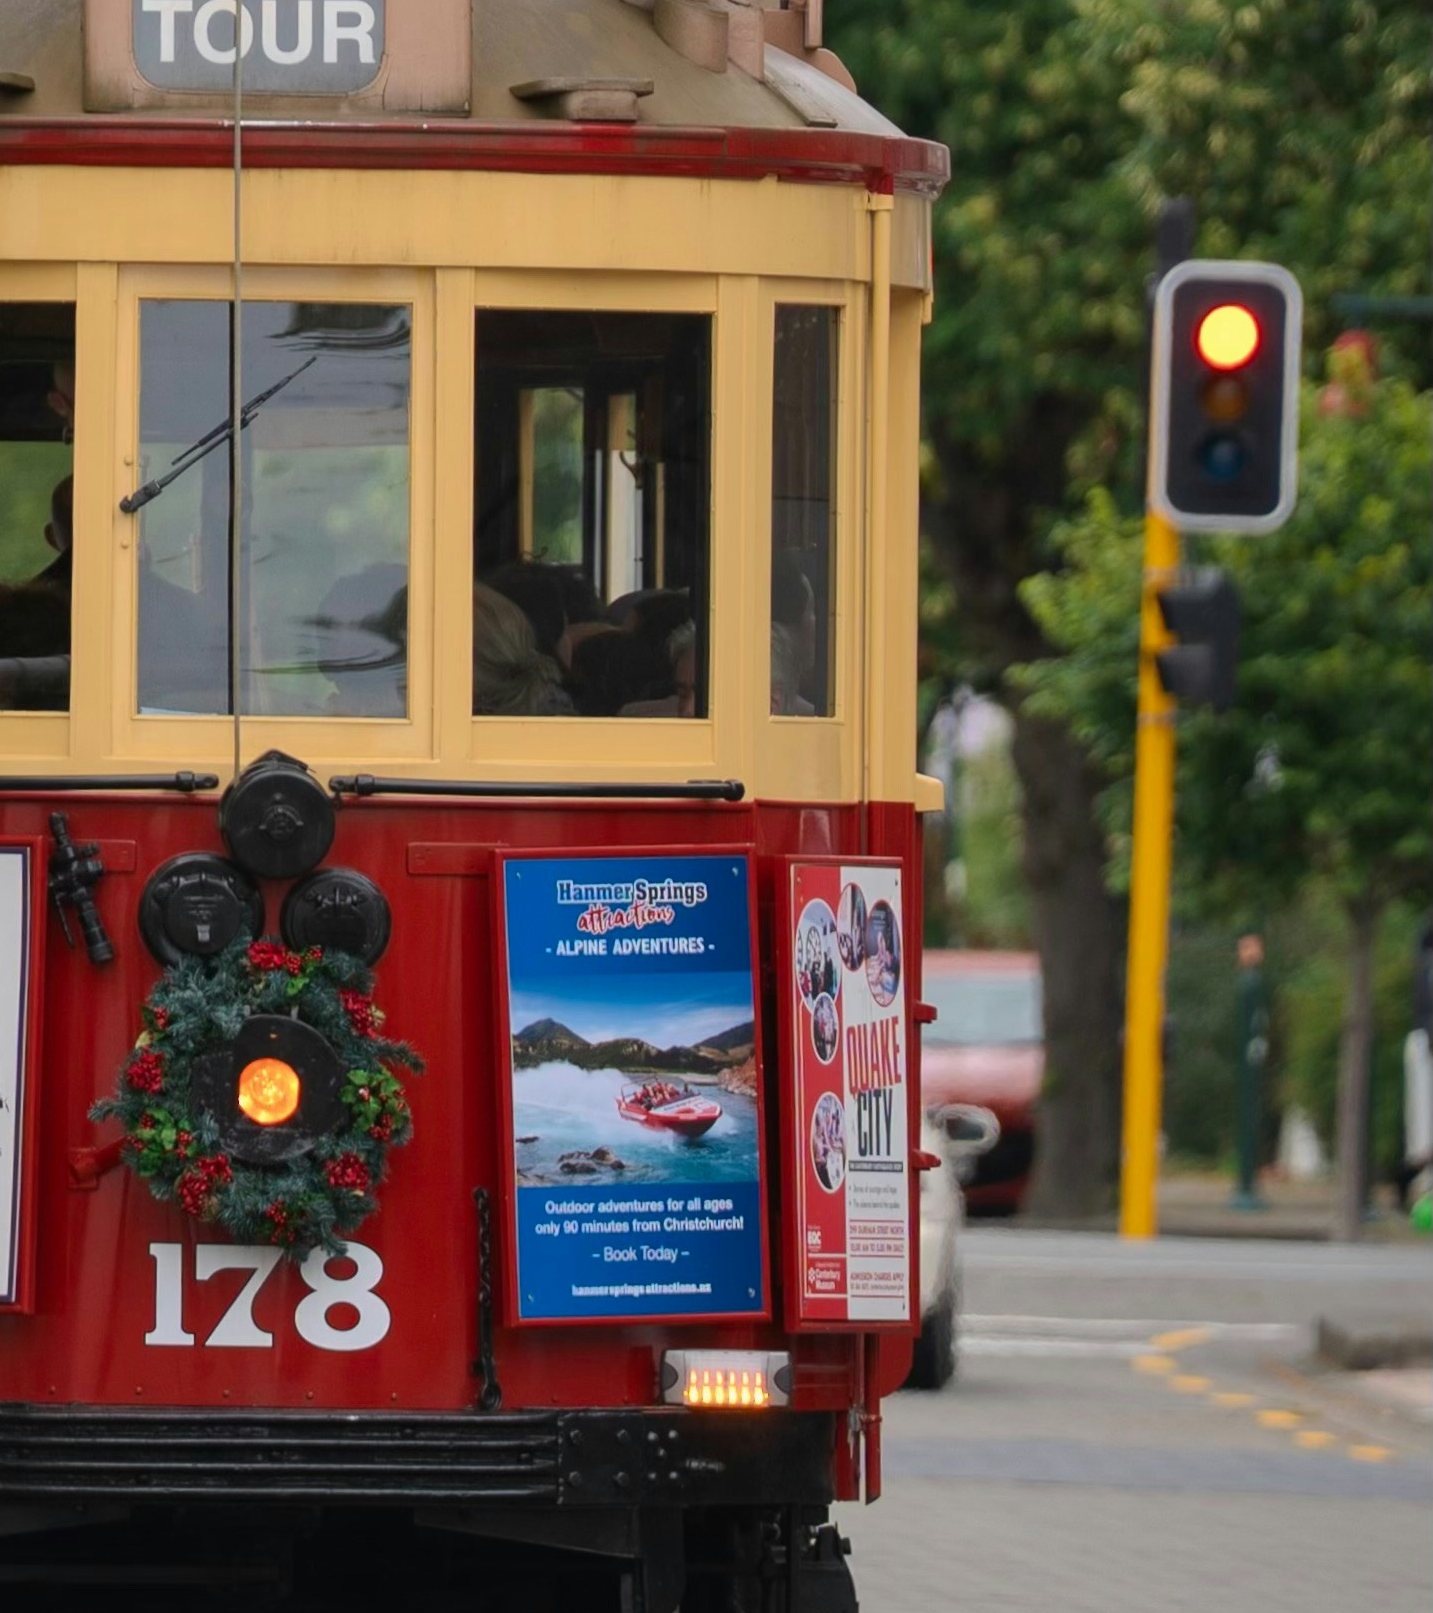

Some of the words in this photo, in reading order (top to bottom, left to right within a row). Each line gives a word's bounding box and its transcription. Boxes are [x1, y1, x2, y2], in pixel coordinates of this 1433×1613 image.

[557, 879, 632, 903] Hanmer
[634, 878, 707, 907] Springs
[577, 901, 675, 935] attractions
[556, 939, 607, 956] ALPINE
[613, 937, 705, 955] ADVENTURES
[846, 1015, 902, 1097] QUAKE
[857, 1087, 893, 1157] CITY
[545, 1200, 595, 1215] Outdoor
[598, 1199, 664, 1214] adventures
[667, 1198, 685, 1212] for
[687, 1197, 701, 1211] all
[704, 1198, 733, 1214] ages
[535, 1221, 560, 1237] only
[563, 1220, 579, 1234] 90
[581, 1219, 629, 1234] minutes
[632, 1218, 661, 1233] from
[663, 1216, 744, 1232] Christchurch!
[603, 1246, 637, 1262] Book
[640, 1245, 678, 1263] Today
[144, 1240, 391, 1351] 178
